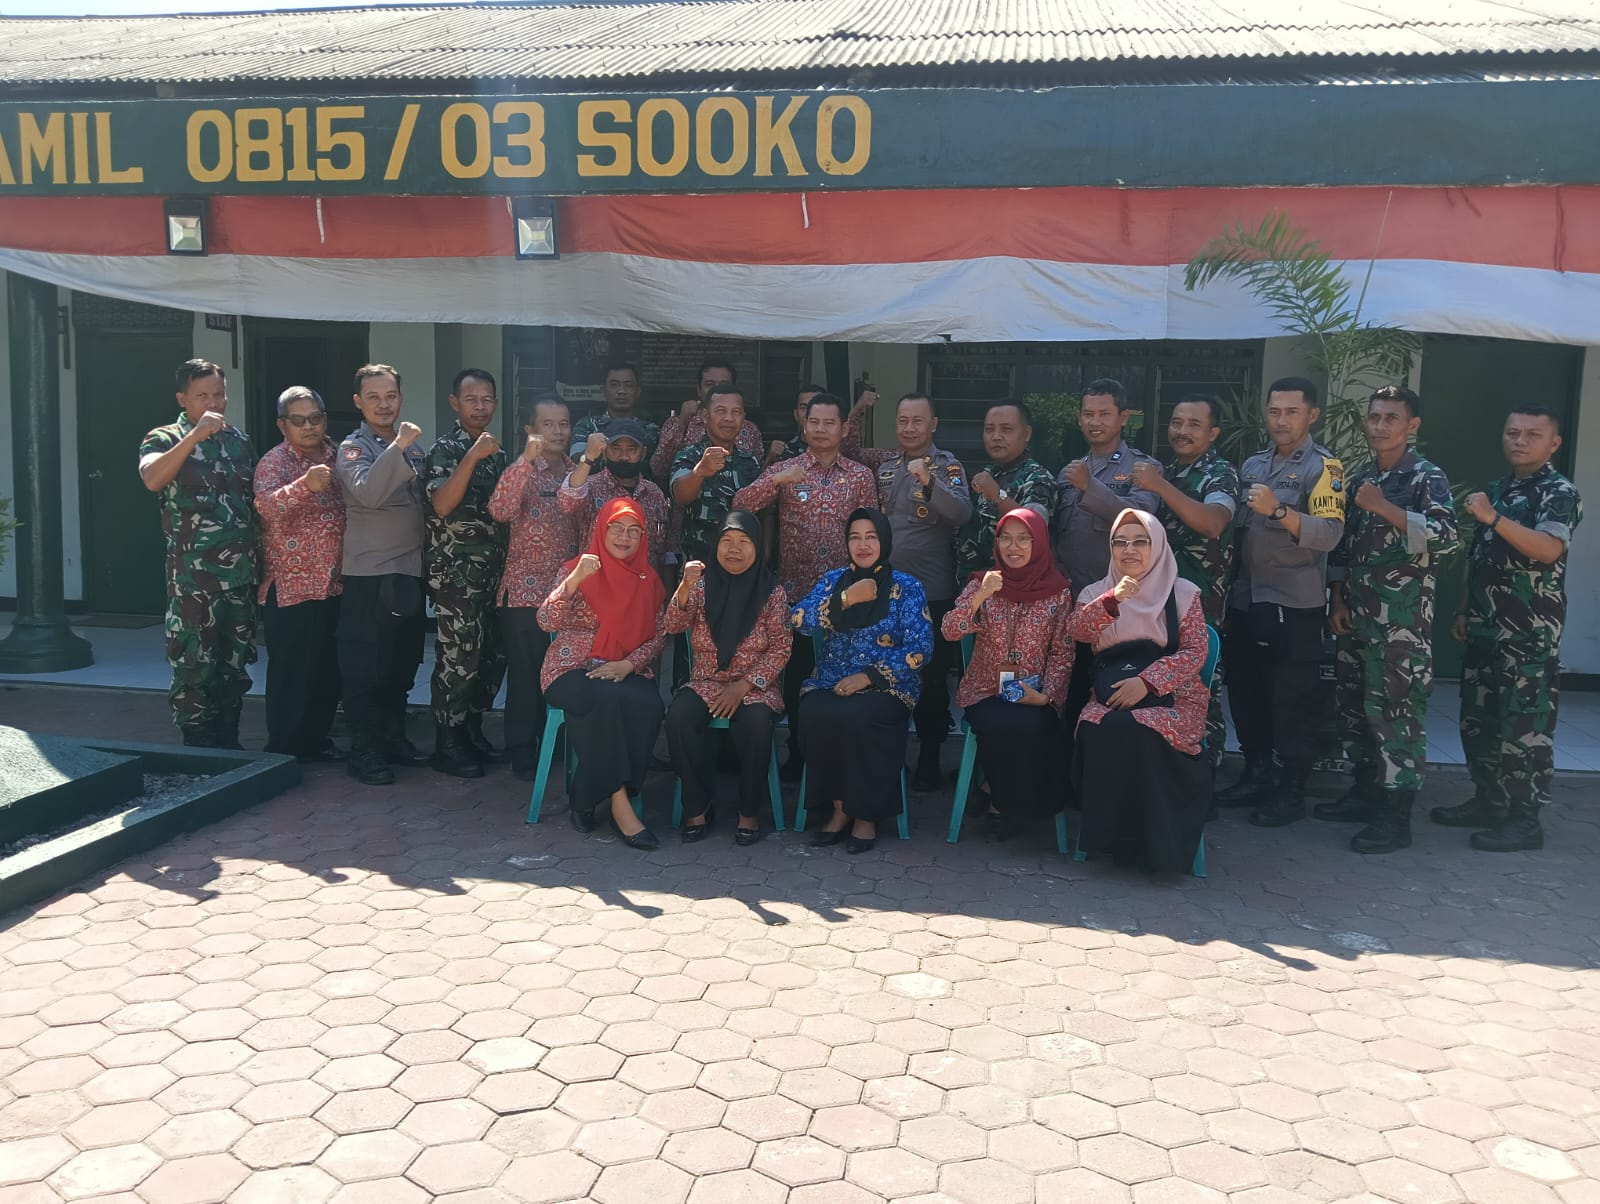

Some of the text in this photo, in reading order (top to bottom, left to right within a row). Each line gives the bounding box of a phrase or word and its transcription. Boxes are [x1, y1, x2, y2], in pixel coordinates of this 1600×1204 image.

[186, 105, 365, 183] 0815
[440, 101, 546, 178] 03
[576, 95, 872, 177] SOOKO
[1313, 495, 1333, 510] KANIT
